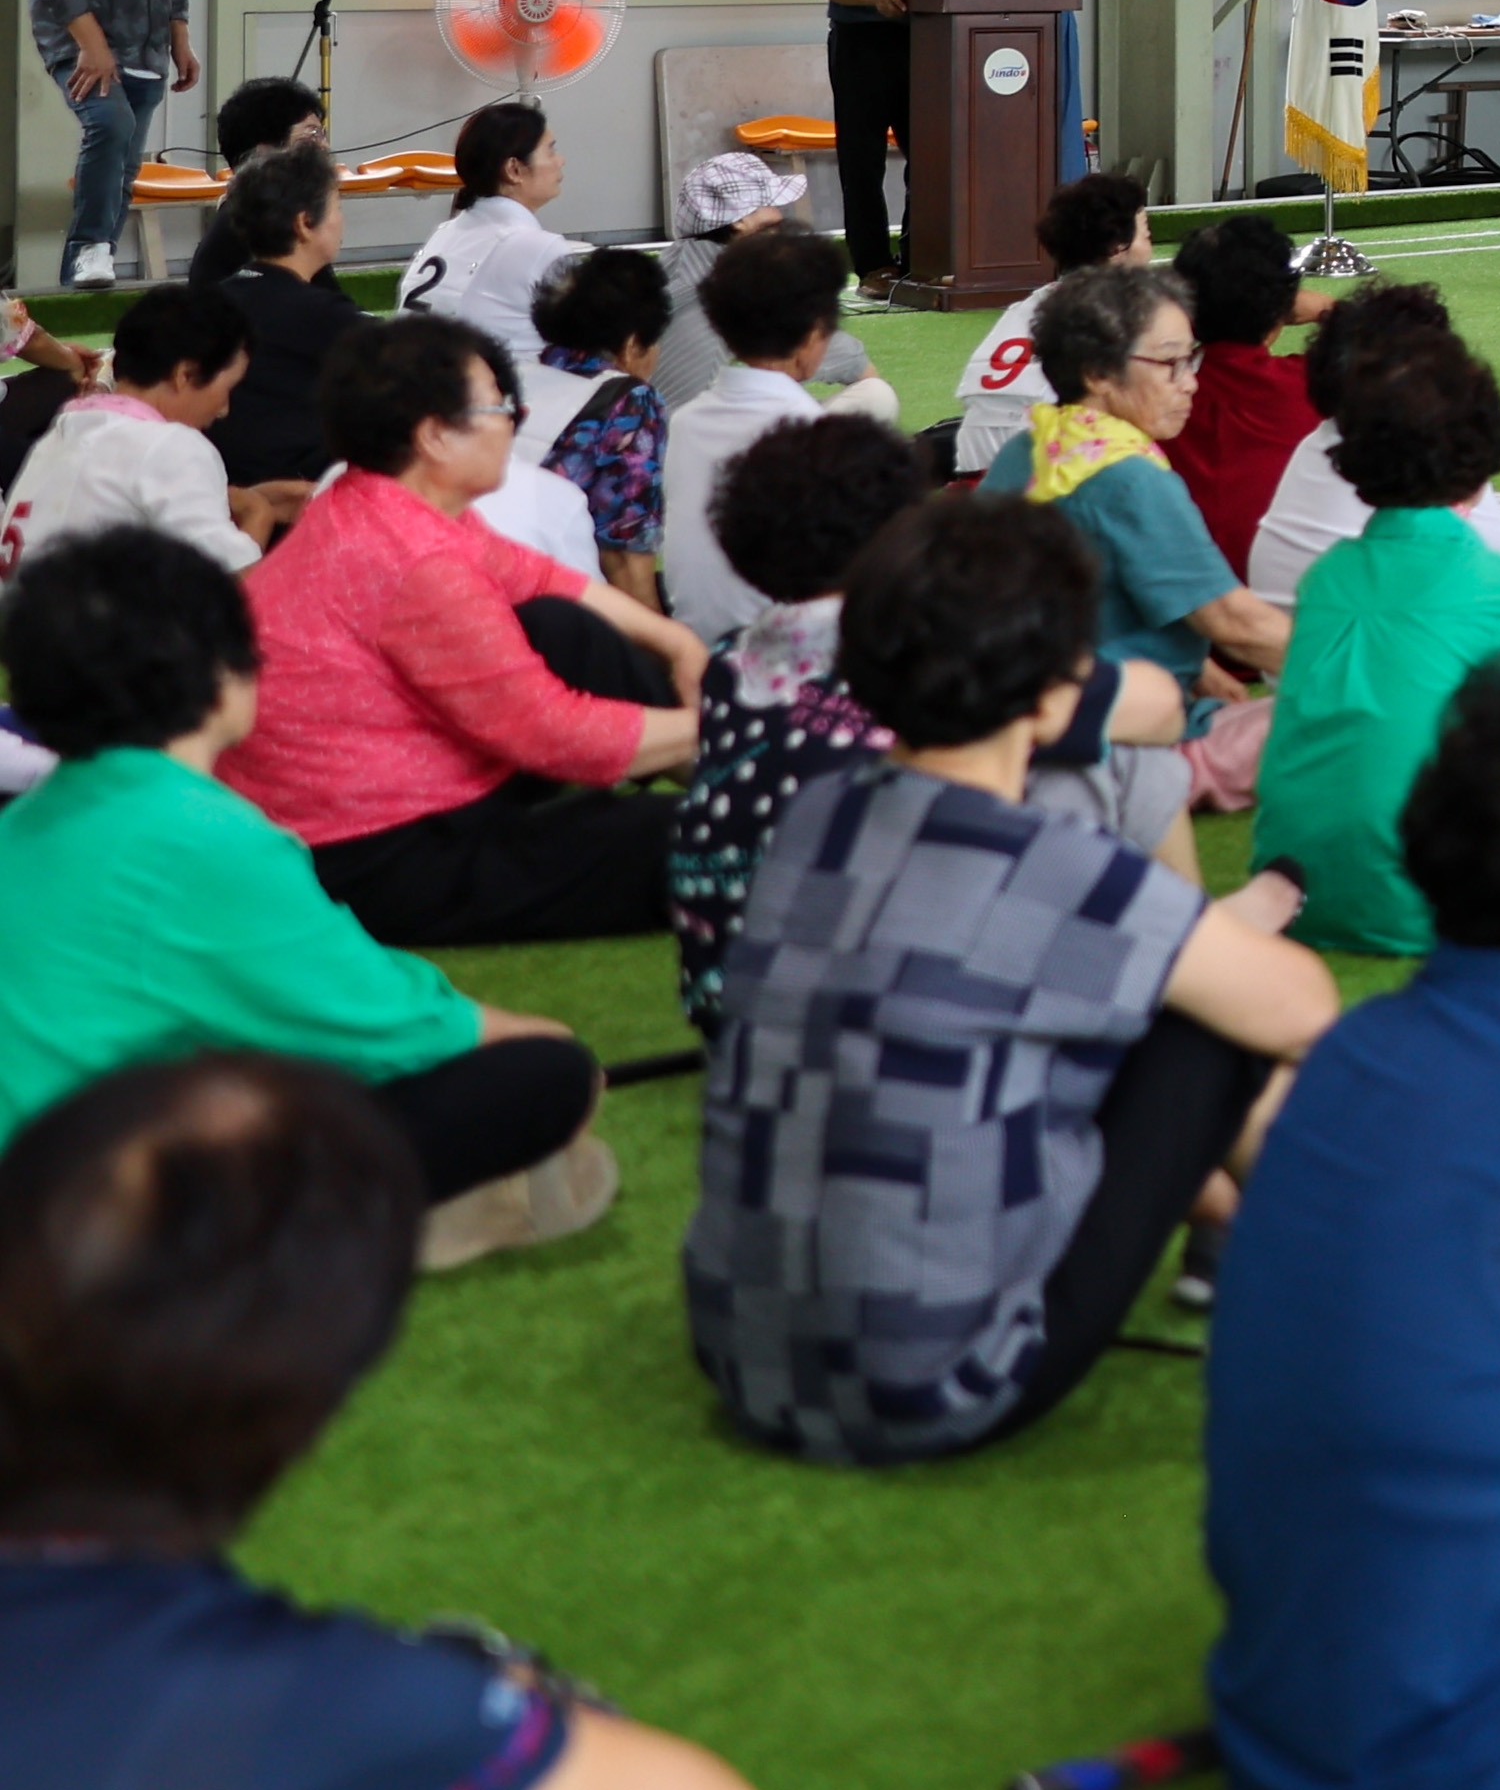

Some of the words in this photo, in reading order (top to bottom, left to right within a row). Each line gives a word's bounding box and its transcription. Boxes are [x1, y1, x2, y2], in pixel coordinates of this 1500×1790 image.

[988, 69, 1020, 79] Jindo
[404, 257, 449, 312] 2
[979, 336, 1035, 391] 9
